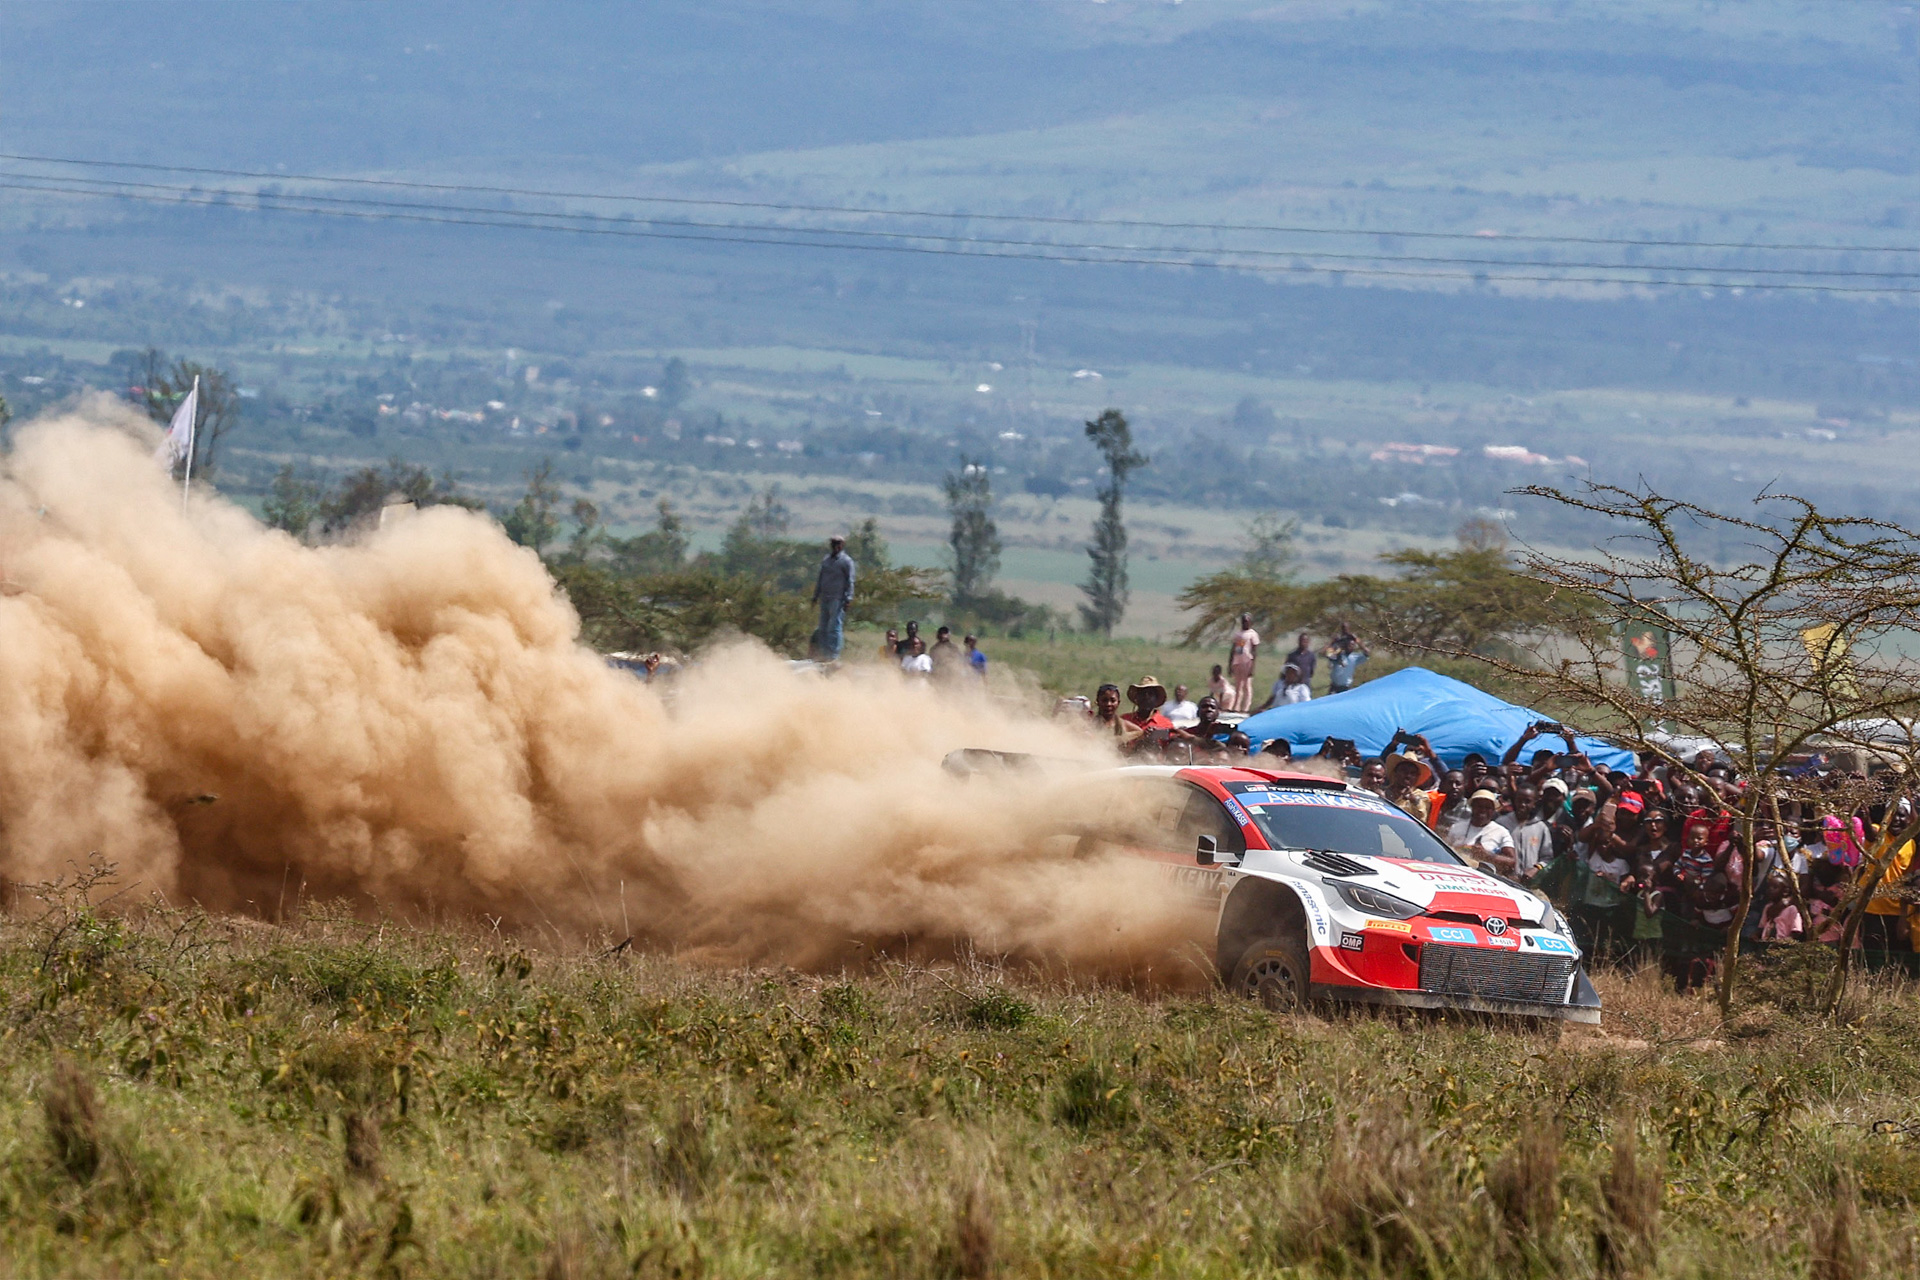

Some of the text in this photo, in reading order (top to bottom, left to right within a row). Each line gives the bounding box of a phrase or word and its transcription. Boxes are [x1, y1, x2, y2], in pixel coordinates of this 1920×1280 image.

[1176, 867, 1219, 892] KENY
[1418, 873, 1498, 887] DENSO
[1435, 883, 1509, 897] DMG MORI
[1342, 937, 1363, 947] OMP
